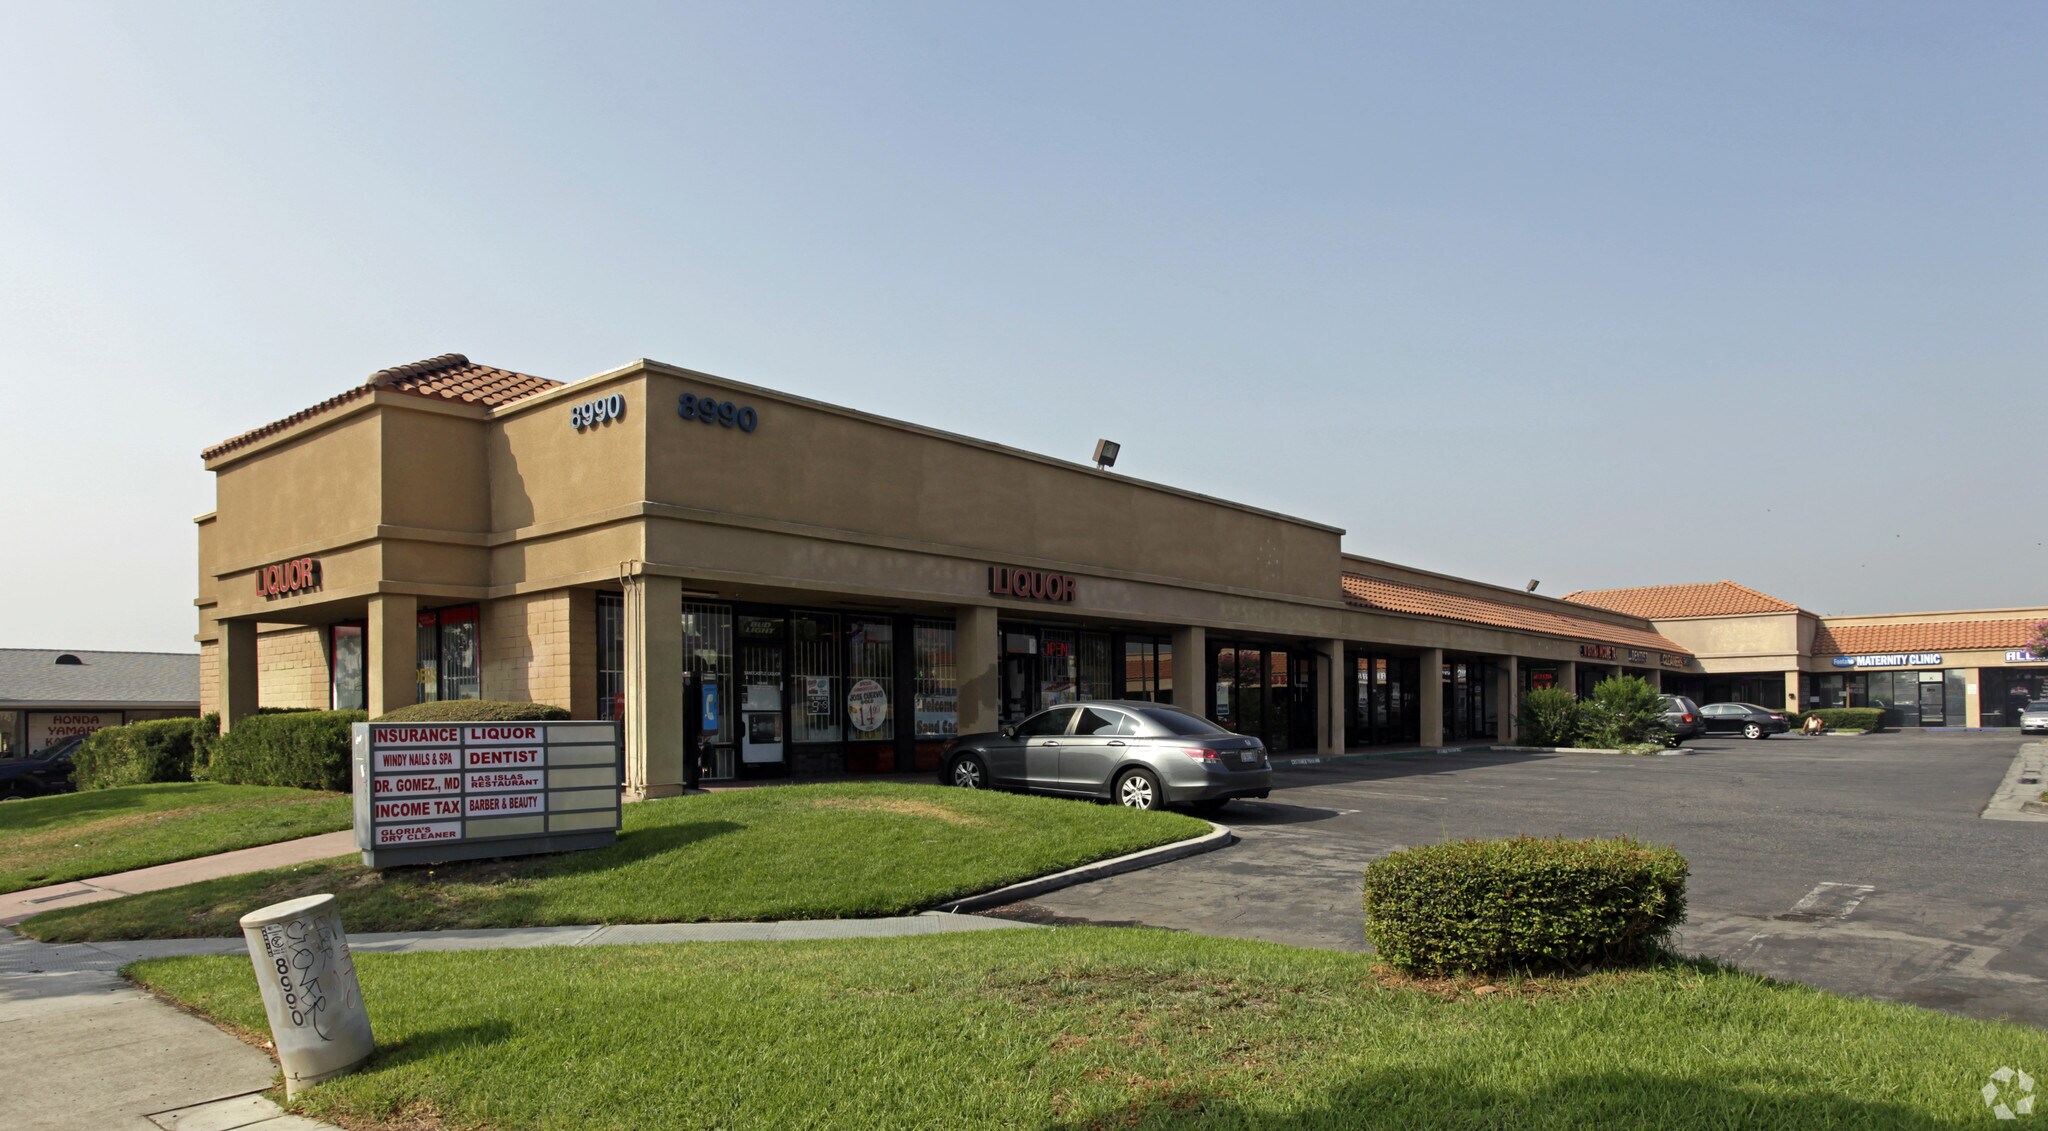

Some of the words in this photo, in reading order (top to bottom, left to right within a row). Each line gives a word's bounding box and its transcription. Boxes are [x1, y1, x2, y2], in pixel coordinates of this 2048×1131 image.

[571, 392, 623, 430] 8990
[678, 392, 758, 432] 8990
[255, 557, 313, 597] LIQUOR
[991, 565, 1077, 601] LIQUOR
[1856, 654, 1908, 667] MATERNITY
[1909, 653, 1942, 665] CLINIC
[863, 690, 883, 699] CUERVO
[53, 715, 100, 724] HONDA
[917, 720, 940, 734] Sand
[374, 727, 457, 743] INSURANCE
[471, 727, 536, 740] LIQUOR
[383, 754, 407, 767] WINDY
[408, 753, 430, 766] NAILS
[431, 753, 437, 765] &
[439, 752, 453, 765] SPA
[469, 750, 538, 765] DENTIST
[374, 779, 393, 793] DR.
[444, 776, 460, 790] MD
[471, 775, 493, 783] LAS
[495, 773, 524, 781] ISLAS
[471, 779, 539, 788] RESTAURANT
[375, 802, 430, 818] INCOME
[436, 800, 460, 815] TAX
[469, 798, 500, 812] BARBER
[501, 797, 507, 810] &
[509, 795, 538, 809] BEAUTY
[381, 826, 432, 836] GLORIA'S
[381, 834, 404, 843] DRY
[406, 831, 457, 842] CLEANER
[275, 957, 304, 1027] 8990
